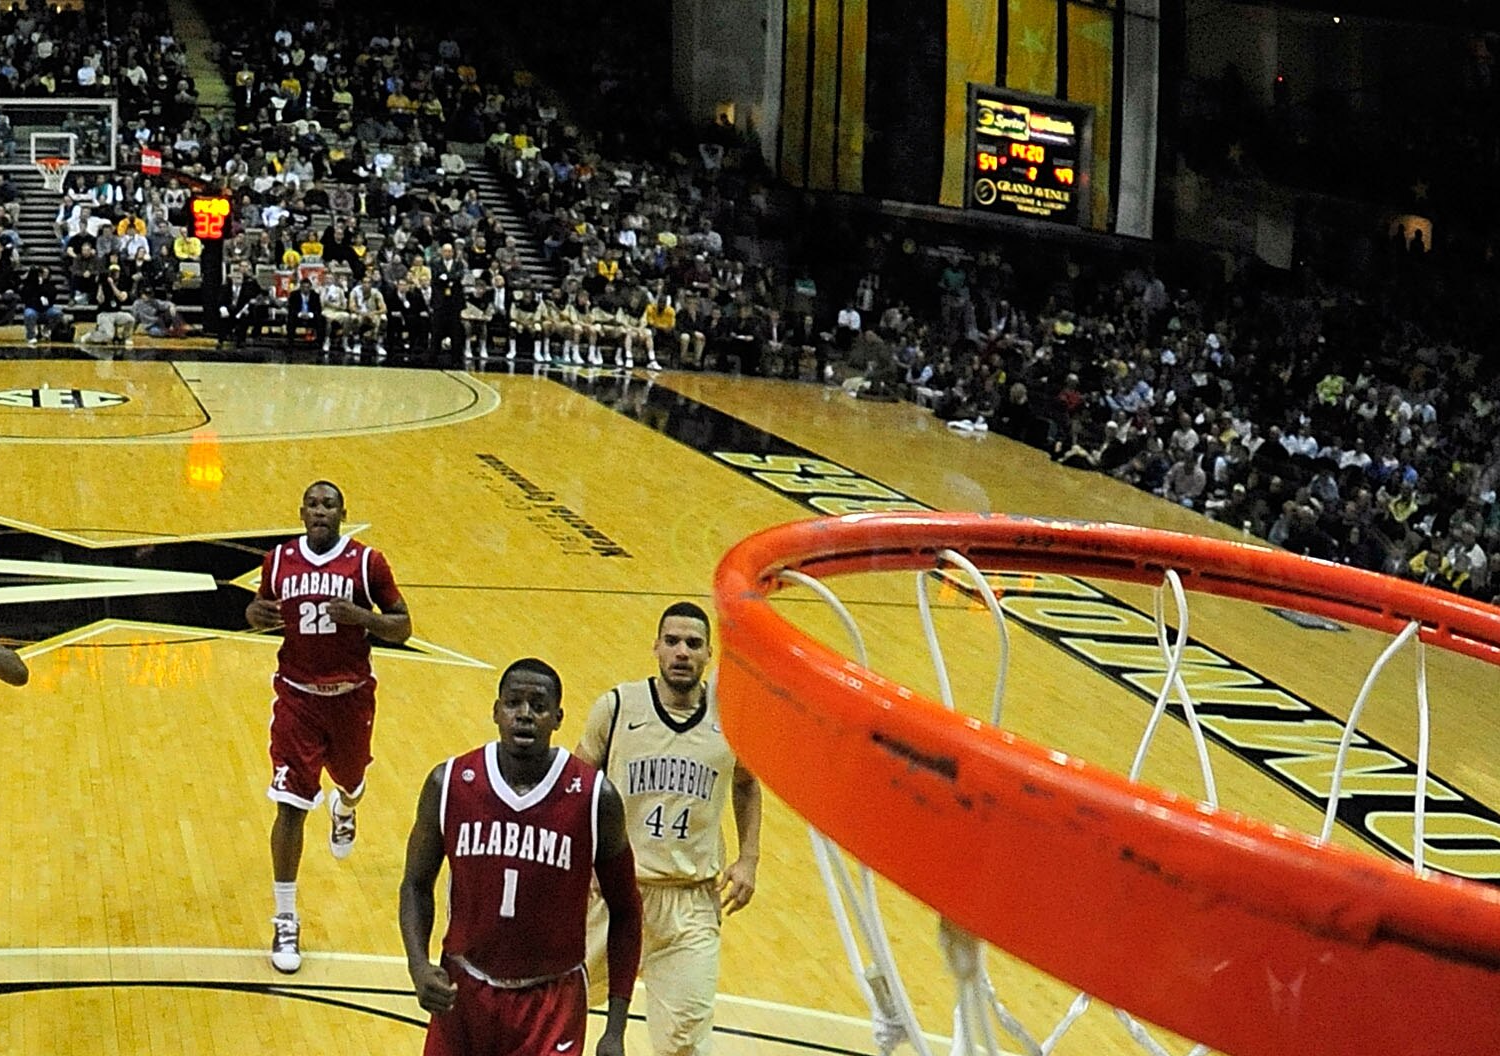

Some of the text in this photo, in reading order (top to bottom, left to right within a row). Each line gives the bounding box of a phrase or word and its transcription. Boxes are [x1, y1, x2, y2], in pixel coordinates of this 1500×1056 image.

[997, 181, 1033, 195] GRAND
[282, 571, 354, 601] ALABAMA
[299, 601, 337, 635] 22
[628, 756, 719, 801] VANDERBILT
[645, 803, 690, 840] 44
[455, 821, 572, 871] ALABAMA
[499, 868, 519, 918] 1
